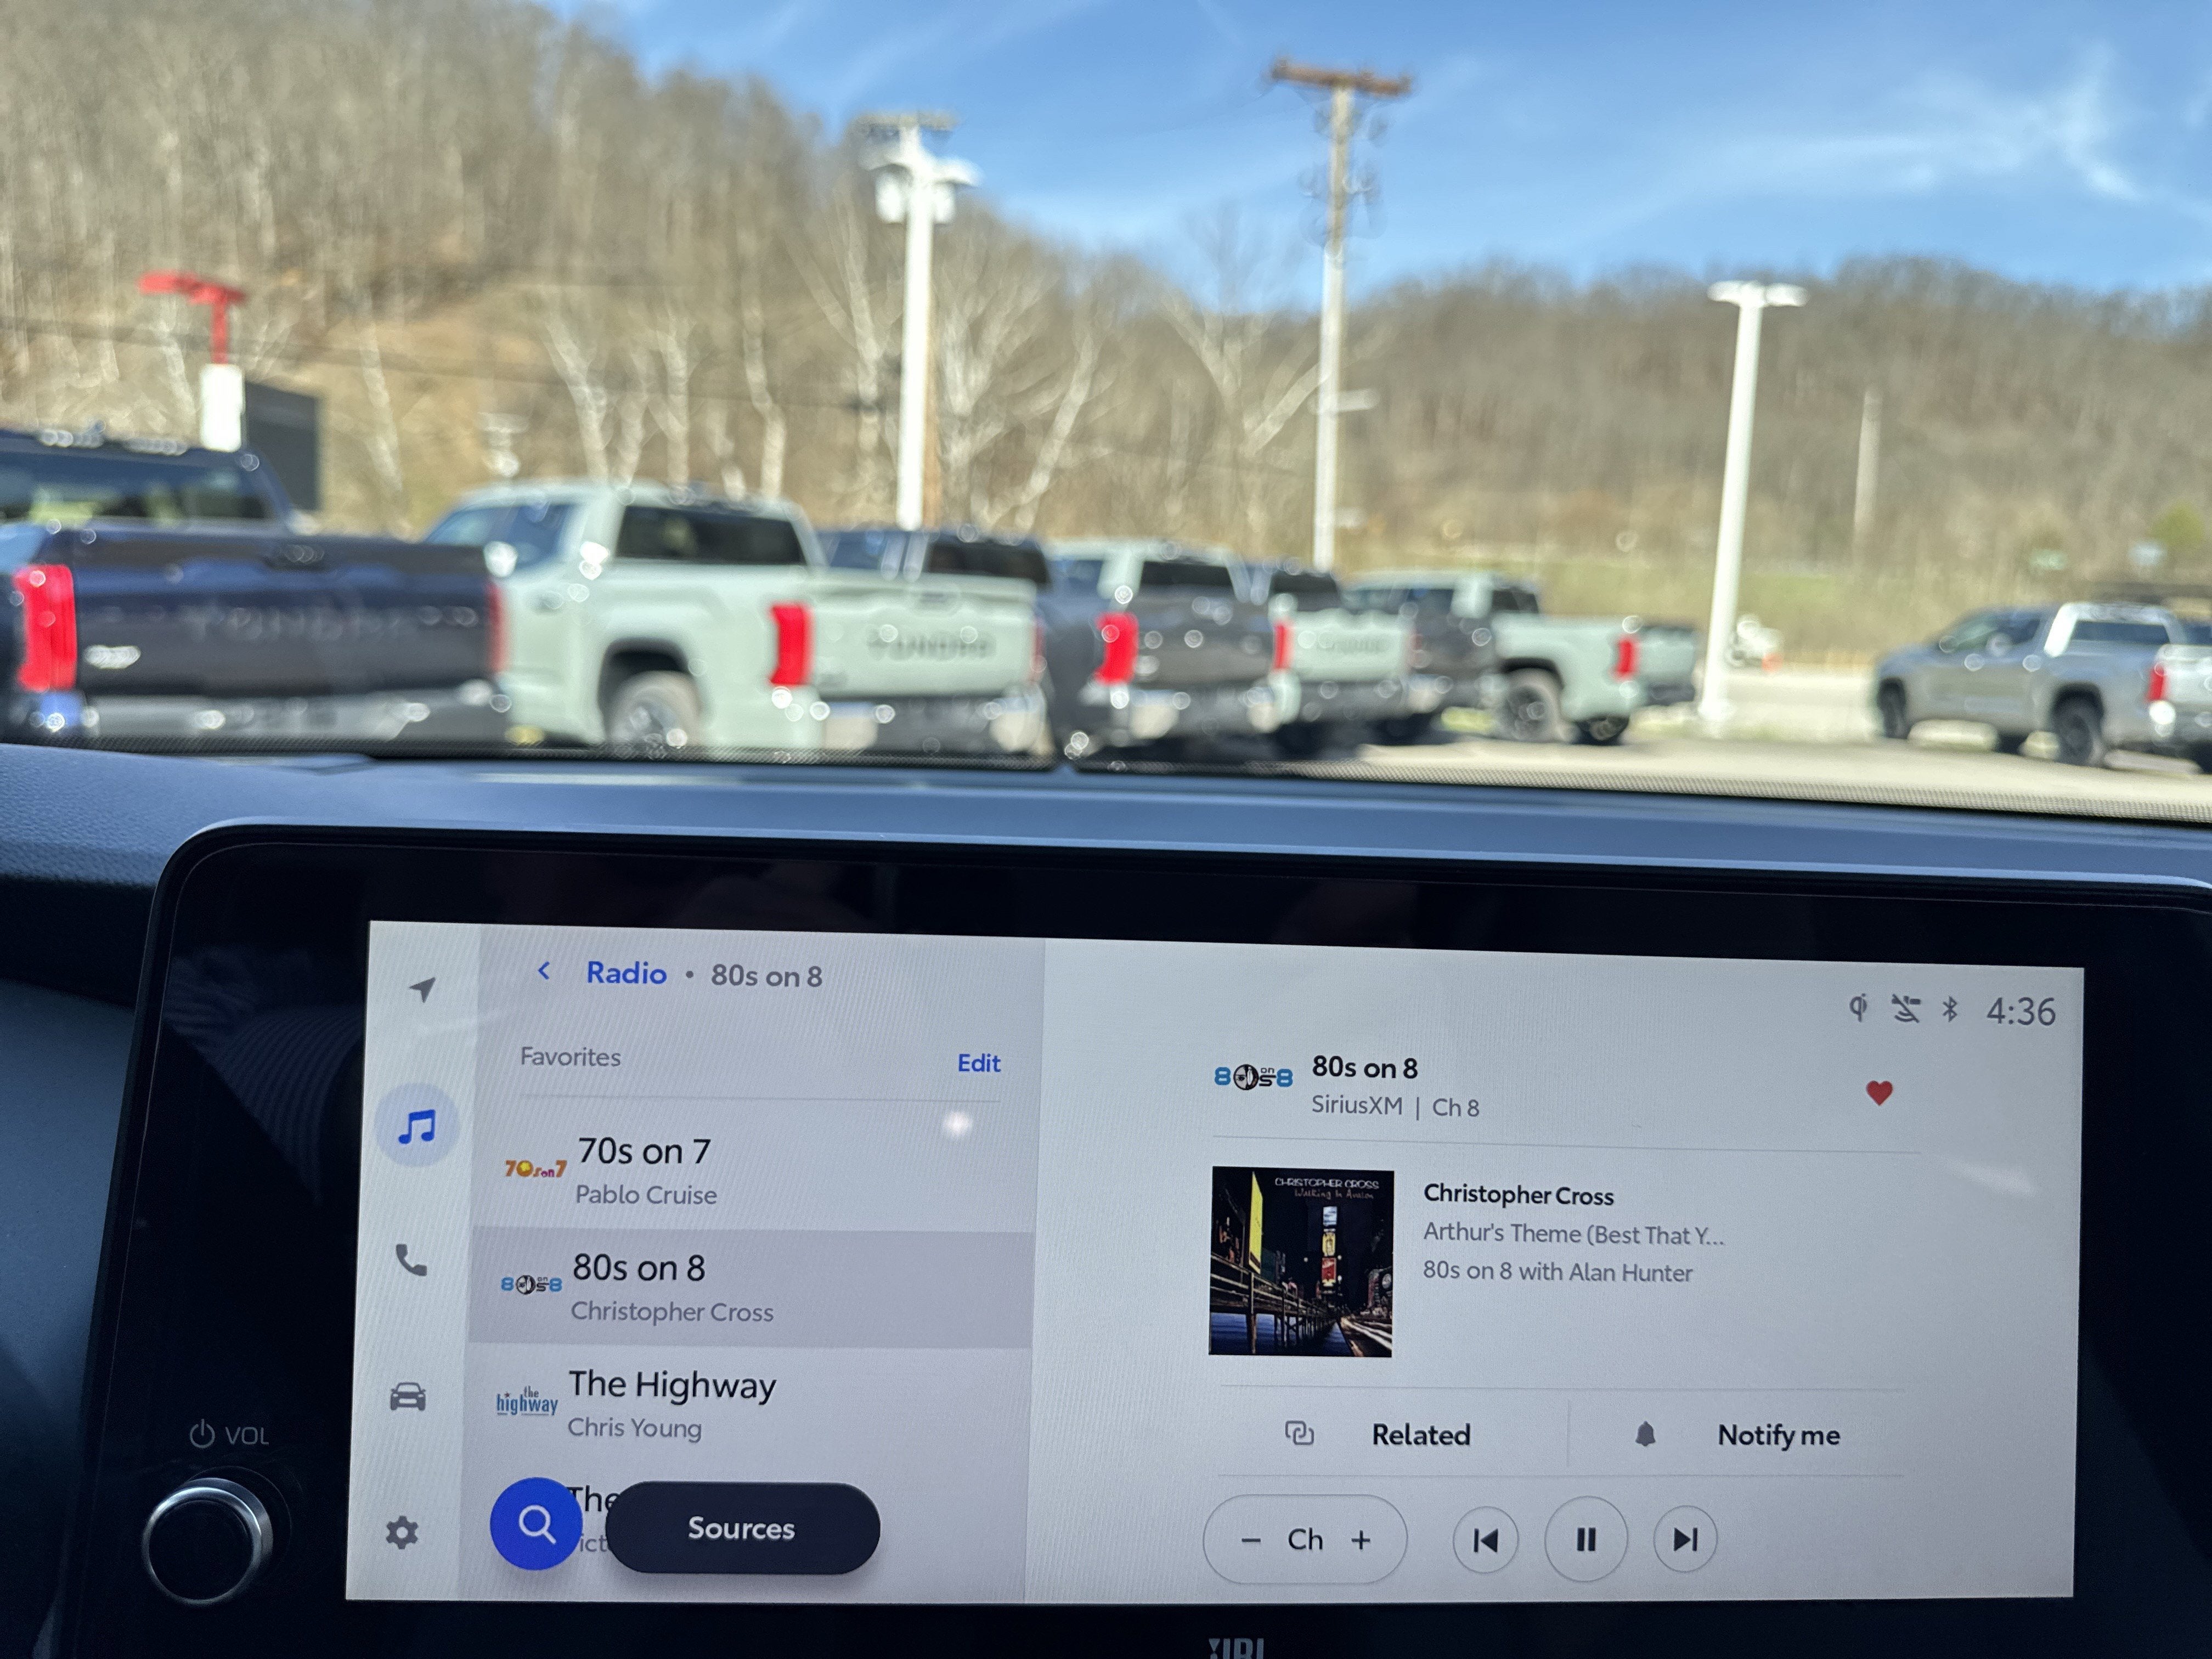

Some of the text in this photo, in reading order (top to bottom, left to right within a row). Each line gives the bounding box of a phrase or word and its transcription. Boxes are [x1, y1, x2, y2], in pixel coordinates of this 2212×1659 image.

[588, 961, 667, 984] Radio
[711, 963, 822, 988] 80s on 8
[1987, 997, 2056, 1026] 4:36
[521, 1046, 621, 1067] Favorites
[958, 1053, 1001, 1073] Edit
[1312, 1055, 1418, 1079] 80s on 8
[1312, 1094, 1480, 1118] SiriusXM Ch 8
[579, 1137, 711, 1165] 70s on 7
[576, 1184, 718, 1205] Pablo Cruise
[1344, 1180, 1380, 1189] CROSS
[1424, 1182, 1615, 1209] Christopher Cross
[1423, 1221, 1504, 1242] Arthur's
[1510, 1223, 1582, 1243] Theme
[1587, 1224, 1640, 1246] (Best
[1645, 1226, 1691, 1245] That
[573, 1253, 705, 1282] 80s on 8
[1423, 1260, 1694, 1283] 80s on 8 with Alan Hunter
[571, 1300, 774, 1327] Christopher Cross
[524, 1385, 539, 1398] the
[569, 1369, 777, 1406] The Highway
[497, 1391, 558, 1416] highway
[225, 1426, 269, 1446] VOL
[567, 1417, 702, 1444] Chris Young
[1373, 1423, 1471, 1446] Related
[1719, 1423, 1841, 1452] Notify me
[689, 1516, 795, 1540] Sources
[1288, 1527, 1323, 1550] Ch
